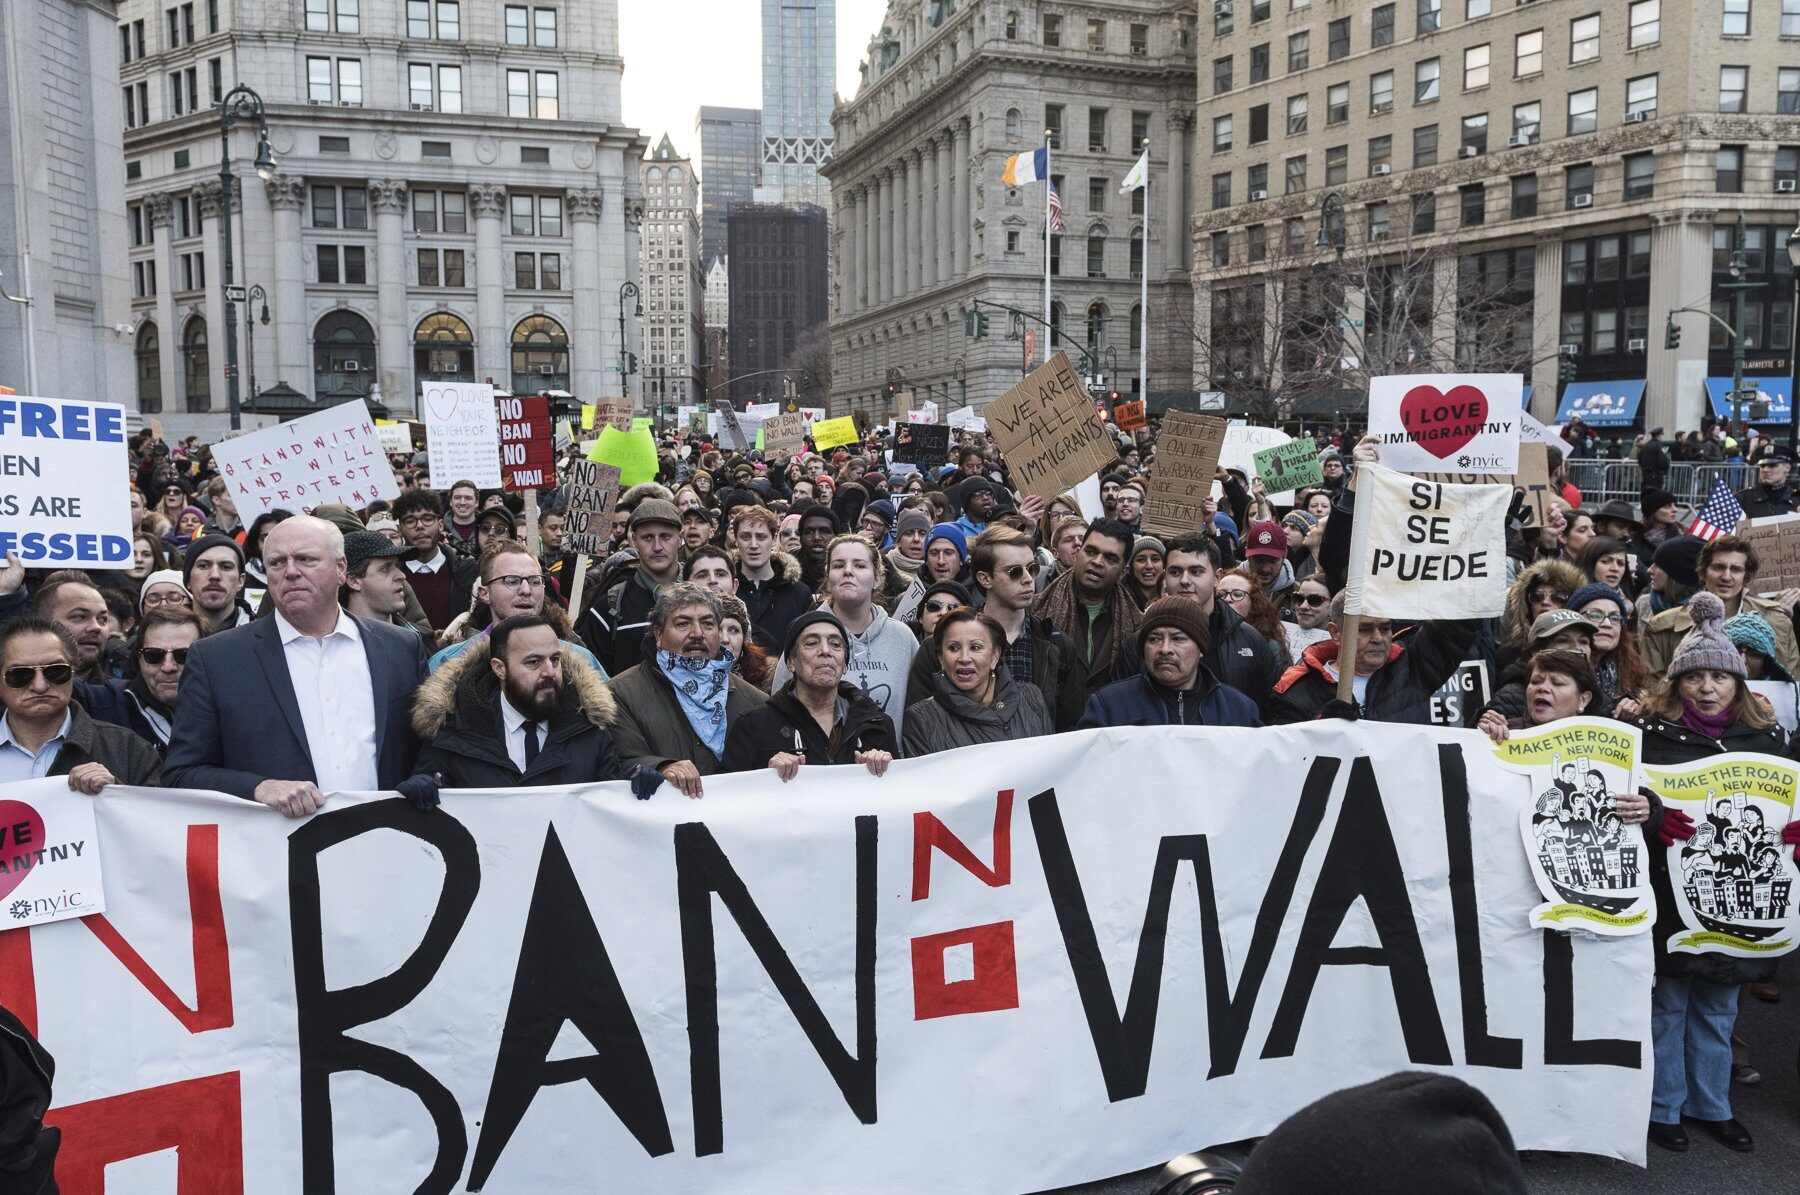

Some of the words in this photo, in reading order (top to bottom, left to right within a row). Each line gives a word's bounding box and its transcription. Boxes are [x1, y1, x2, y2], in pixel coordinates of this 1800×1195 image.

[462, 390, 490, 403] LOVE
[995, 400, 1037, 432] WE
[1039, 369, 1074, 408] ARE
[0, 400, 124, 442] FREE
[500, 399, 522, 420] NO
[1404, 410, 1410, 426] I
[1420, 402, 1480, 423] LOVE
[502, 423, 532, 440] BAN
[767, 420, 780, 430] NO
[784, 416, 799, 426] BAN
[767, 430, 778, 440] NO
[780, 427, 800, 438] WALL
[913, 426, 931, 437] NO
[1030, 407, 1074, 446] ALL
[1208, 426, 1218, 440] BE
[226, 443, 303, 476] STAND
[314, 422, 372, 449] WITH
[917, 436, 944, 448] NAZIS
[1020, 415, 1103, 485] IMMIGRANTS
[1166, 440, 1188, 456] ON
[1191, 442, 1208, 458] THE
[0, 454, 41, 478] EN
[504, 444, 526, 465] NO
[1264, 456, 1284, 476] #1
[1283, 451, 1318, 468] THREAT
[1472, 454, 1504, 470] nyic
[239, 471, 282, 494] AND
[308, 445, 373, 471] WILL
[574, 462, 597, 486] NO
[1157, 461, 1204, 479] WRONG
[260, 466, 370, 508] PROTECT
[1152, 480, 1173, 492] SIDE
[1186, 484, 1198, 496] OF
[1409, 482, 1442, 510] SI
[0, 495, 20, 516] S
[30, 496, 82, 518] ARE
[572, 486, 608, 512] BAN
[1149, 496, 1198, 522] HISTORY
[566, 510, 589, 534] NO
[1407, 514, 1451, 544] SE
[569, 534, 597, 554] WALL
[1371, 548, 1488, 582] PUEDE
[1552, 611, 1581, 622] NYC
[1436, 672, 1474, 692] ING
[1509, 739, 1554, 755] MAKE
[1553, 730, 1584, 746] THE
[1588, 730, 1631, 750] ROAD
[1567, 744, 1594, 756] NEW
[1598, 746, 1629, 762] YORK
[1663, 774, 1708, 789] MAKE
[1709, 766, 1742, 782] THE
[1746, 766, 1794, 786] ROAD
[1722, 780, 1752, 792] NEW
[1756, 782, 1791, 798] YORK
[34, 890, 82, 916] nyic
[1586, 911, 1619, 924] COMUNIDAD
[1624, 916, 1643, 924] PODER
[1724, 938, 1758, 950] COMUNIDAD
[288, 797, 877, 1195] BAN
[911, 789, 1019, 1020] NO
[1028, 743, 1641, 1103] WALL
